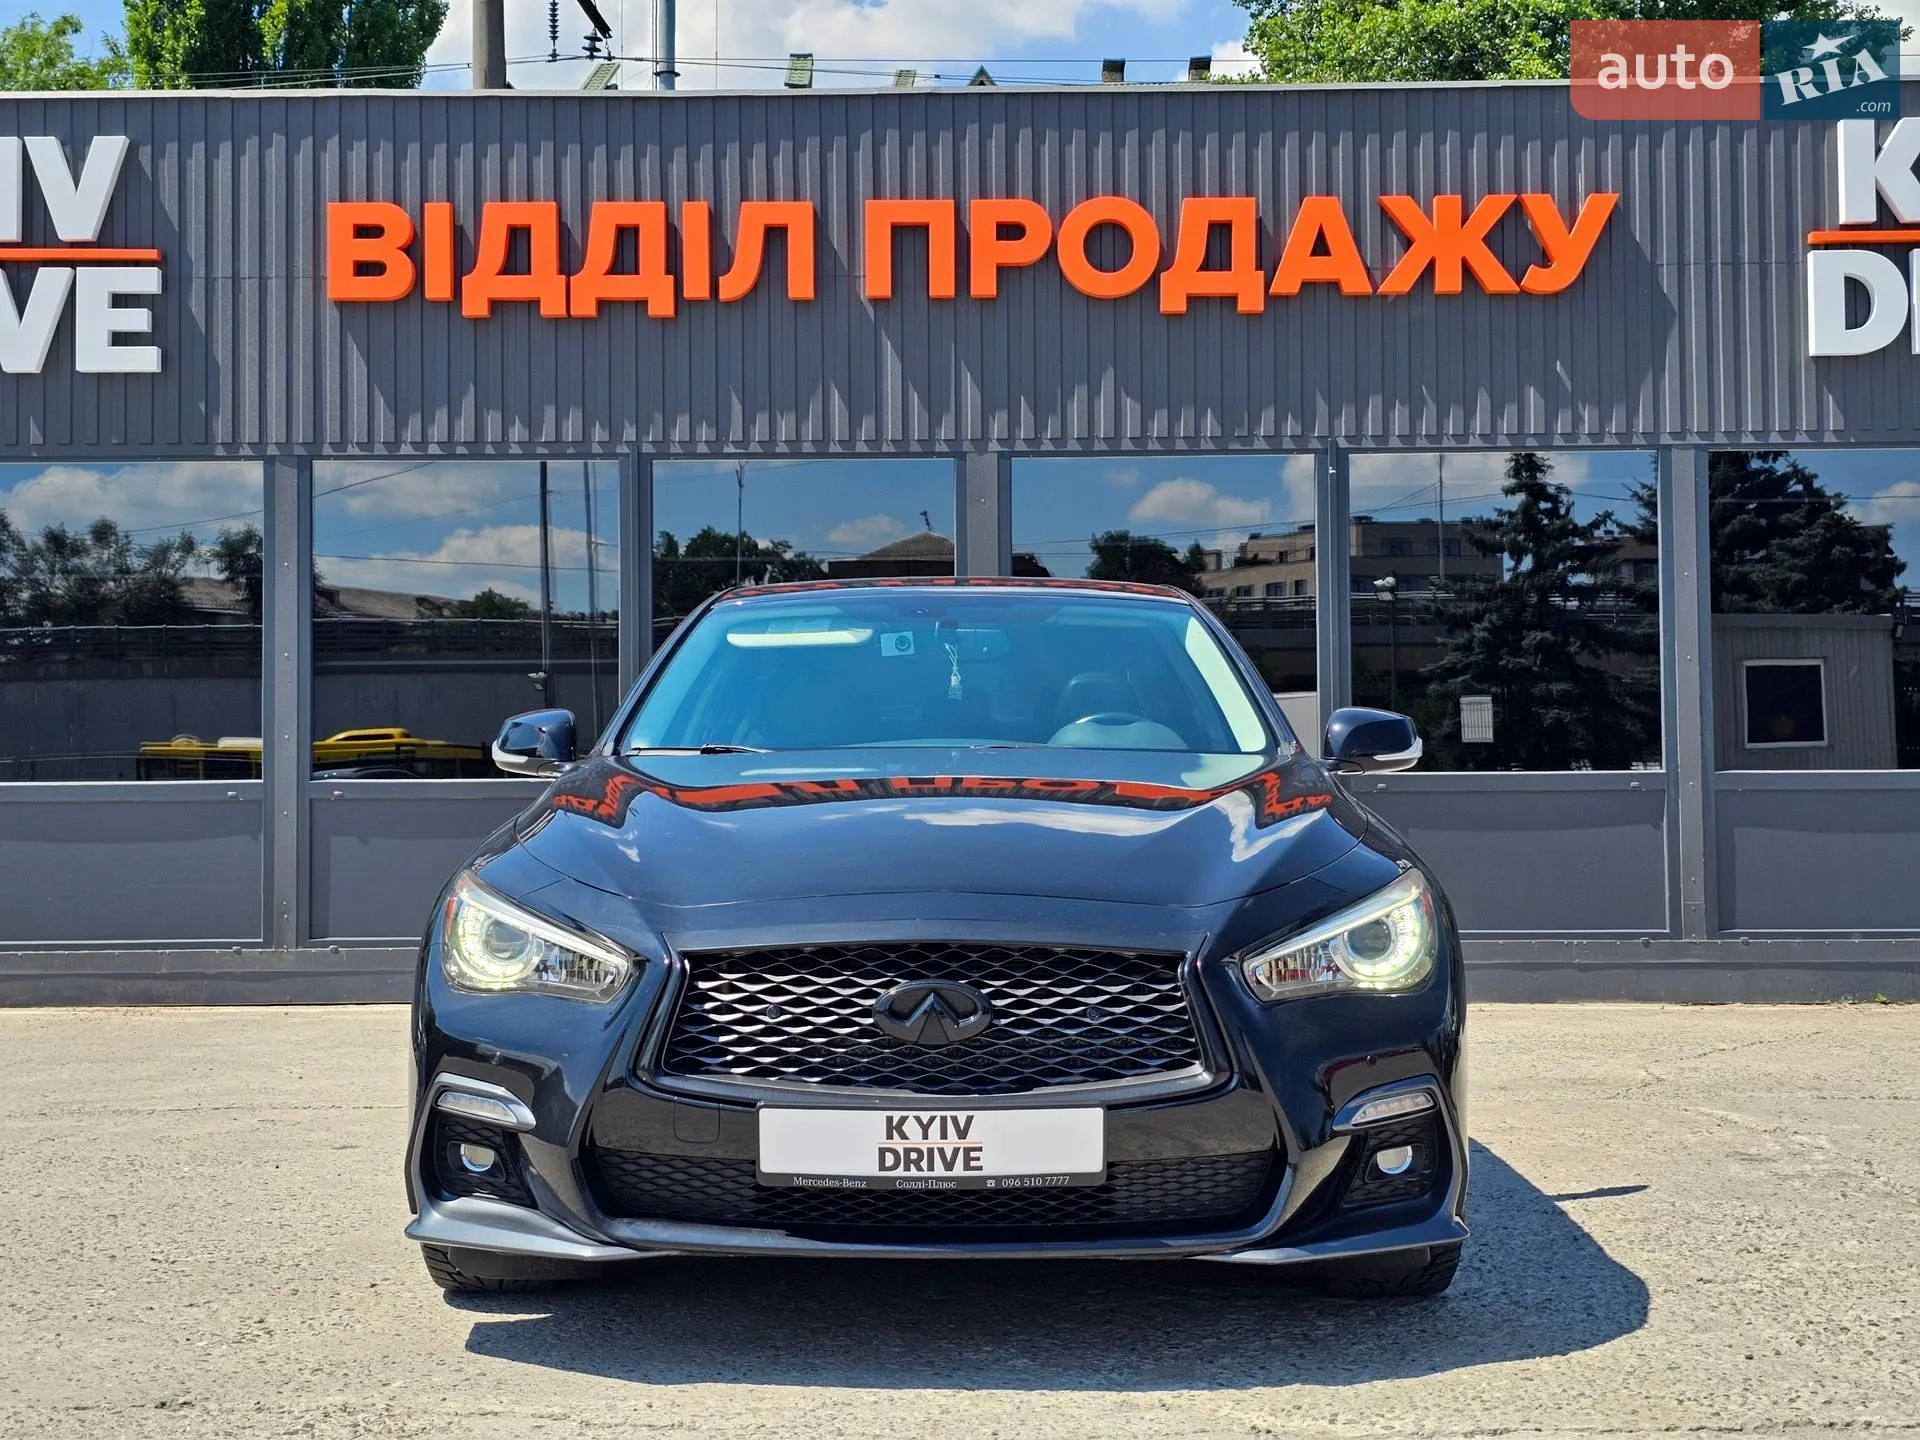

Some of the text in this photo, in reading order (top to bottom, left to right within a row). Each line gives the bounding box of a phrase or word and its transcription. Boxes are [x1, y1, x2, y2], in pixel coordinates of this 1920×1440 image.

[327, 193, 1620, 318] ВІДДІЛ ПРОДАЖУ
[1807, 248, 1920, 357] D
[884, 1114, 975, 1141] KYIV
[877, 1146, 984, 1172] DRIVE
[793, 1176, 867, 1188] Mercedes-Benz
[896, 1179, 957, 1189] Соллі-Плюс
[1002, 1175, 1070, 1188] 096 510 7777
